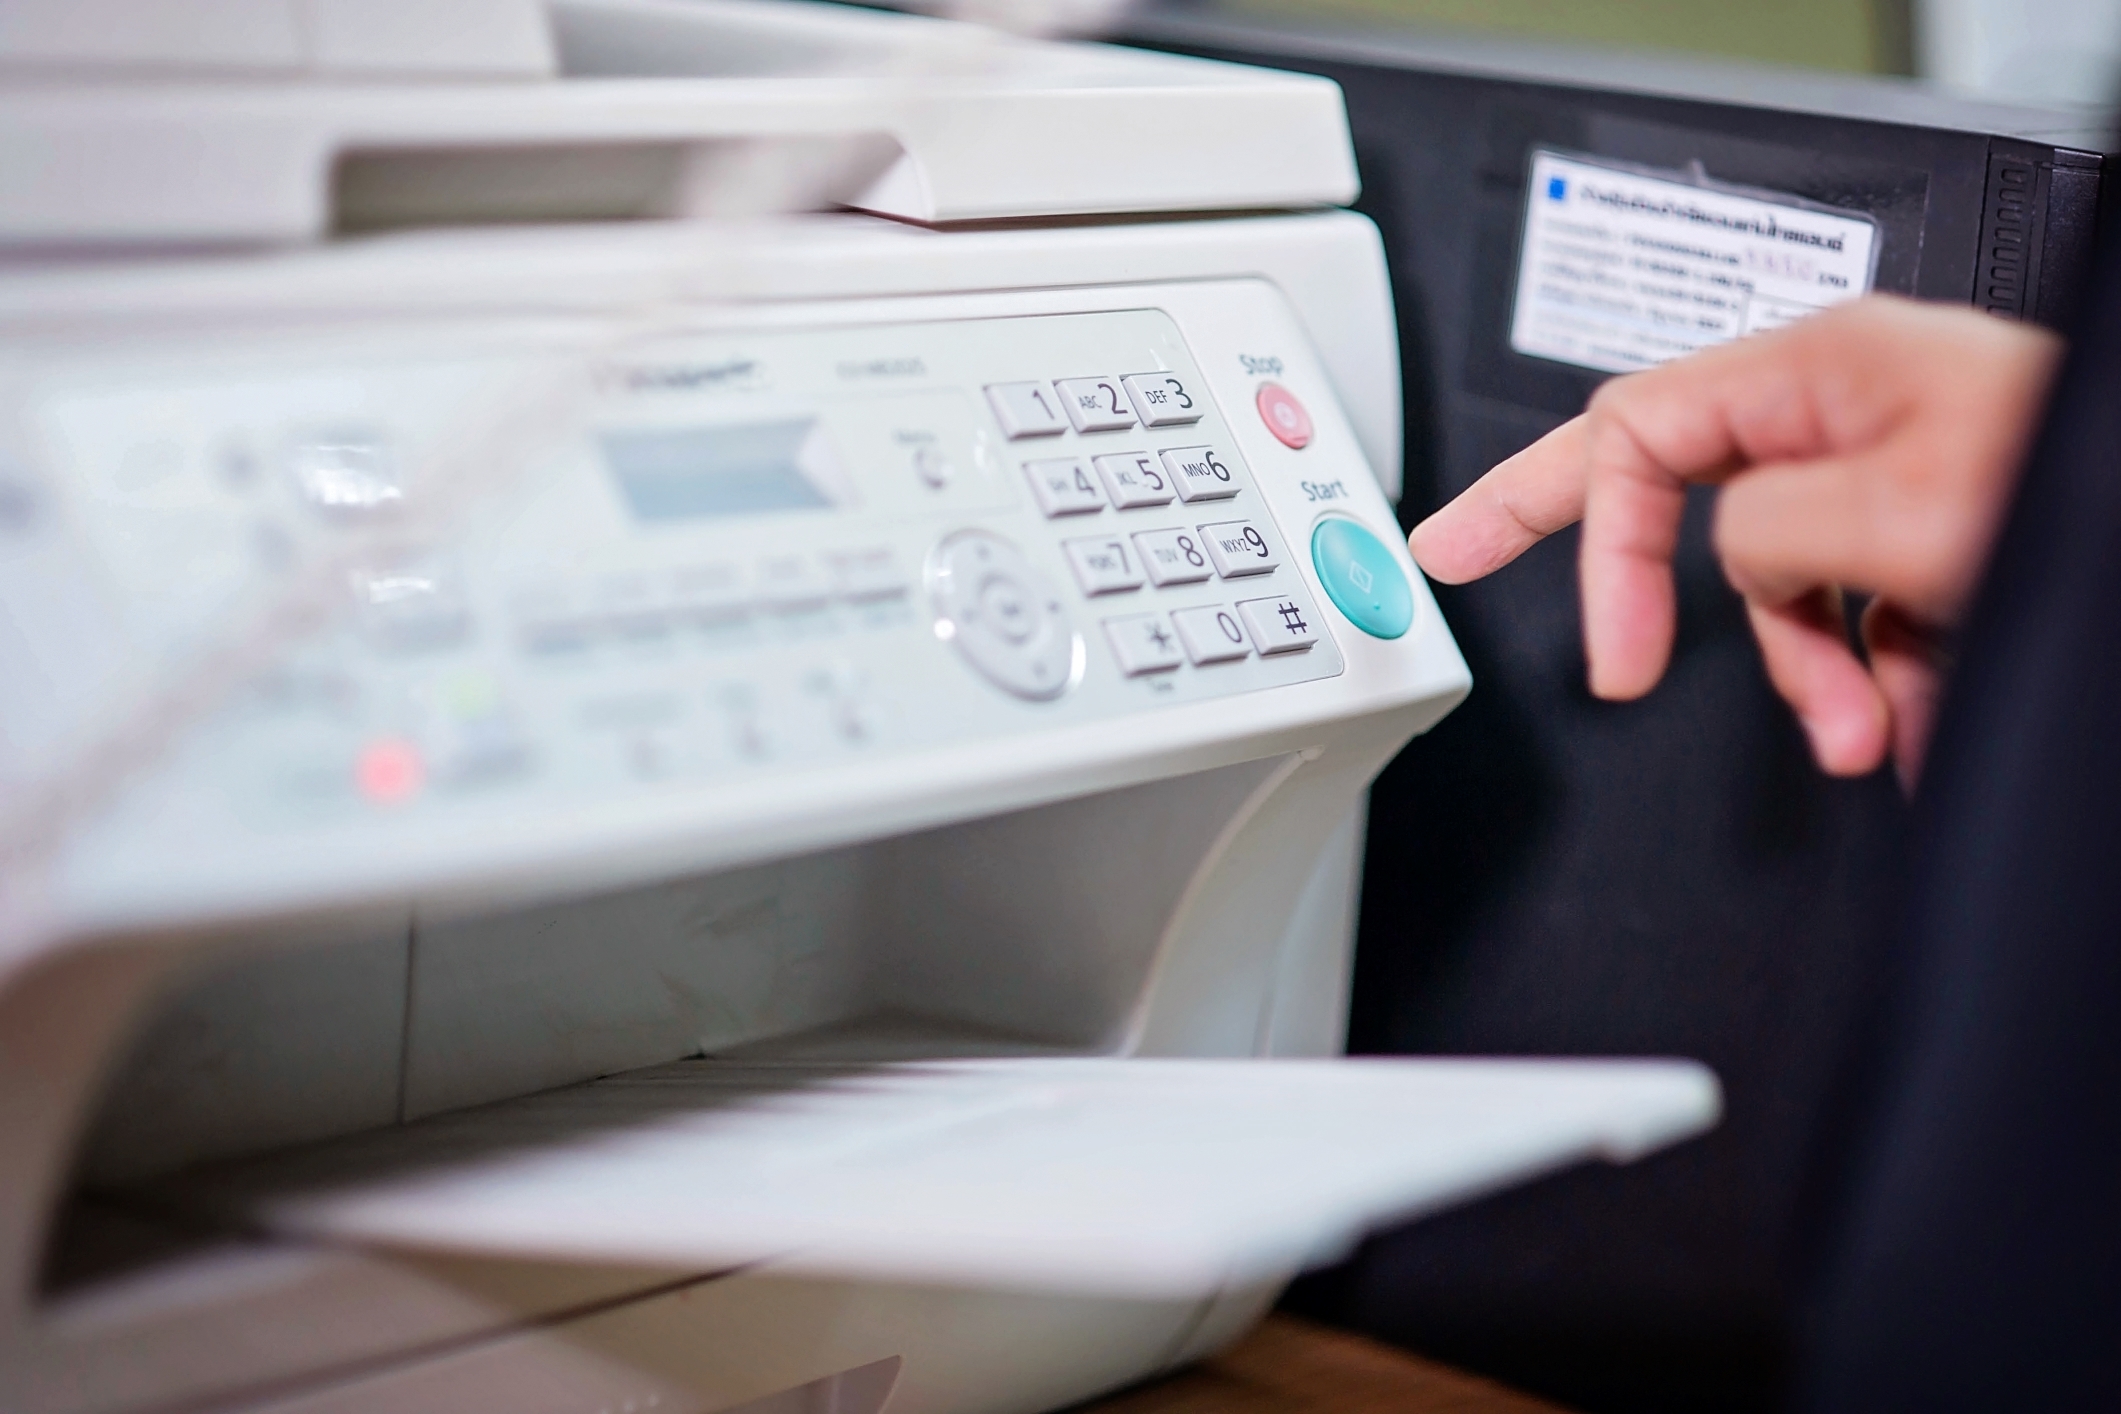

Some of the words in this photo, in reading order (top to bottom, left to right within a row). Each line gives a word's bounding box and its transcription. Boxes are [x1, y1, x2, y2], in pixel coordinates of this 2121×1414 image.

[1238, 354, 1284, 378] Stop
[1032, 388, 1055, 420] 1
[1077, 395, 1103, 410] ABC
[1097, 383, 1128, 415] 2
[1145, 389, 1168, 404] DEF
[1165, 378, 1193, 409] 3
[1073, 466, 1097, 497] 4
[1136, 459, 1164, 491] 5
[1182, 462, 1211, 478] MNO
[1205, 450, 1231, 482] 6
[1301, 479, 1349, 502] Start
[1106, 541, 1131, 575] 7
[1177, 535, 1205, 567] 8
[1218, 538, 1252, 554] WXYZ
[1242, 526, 1269, 558] 9
[1217, 612, 1243, 643] 0
[1278, 601, 1308, 635] #
